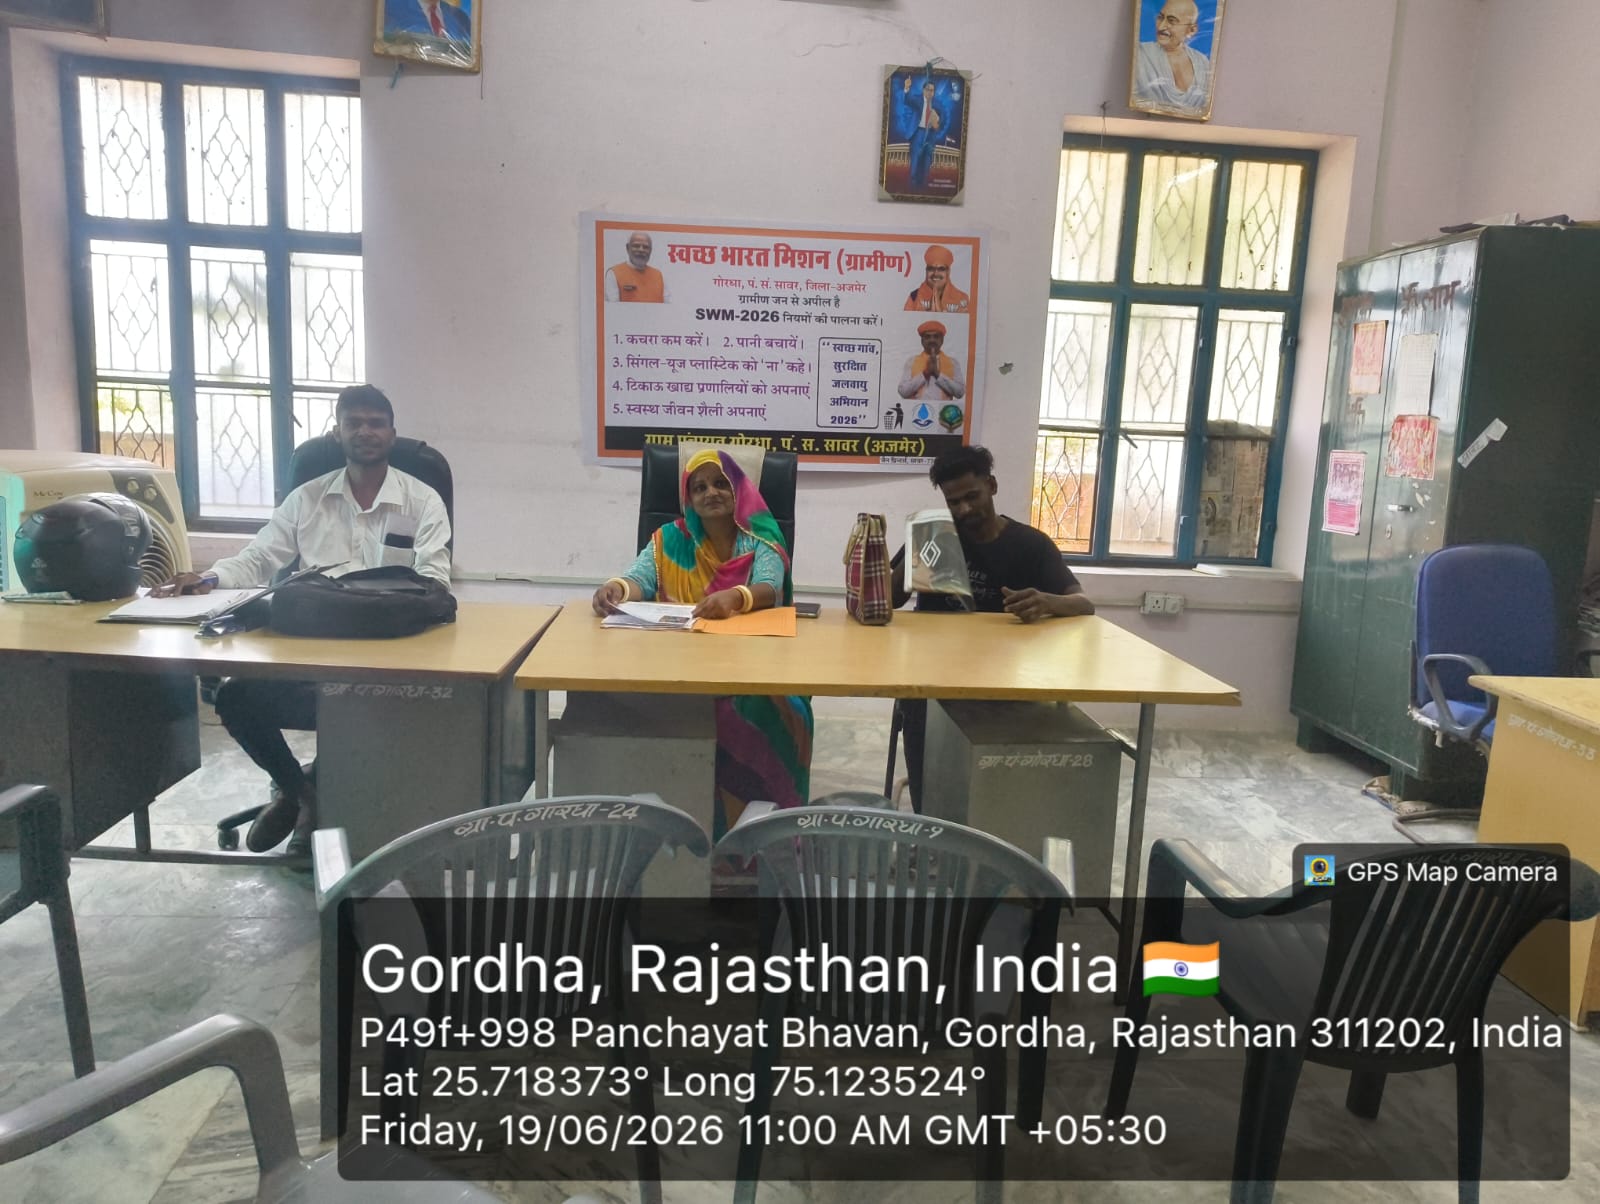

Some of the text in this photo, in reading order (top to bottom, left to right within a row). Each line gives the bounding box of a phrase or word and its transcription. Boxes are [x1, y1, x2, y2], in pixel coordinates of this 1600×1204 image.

[667, 243, 912, 278] स्वच्छ भारत मिशन (ग्रामीण)
[774, 280, 802, 293] सावर,
[738, 293, 841, 309] ग्रामीण जन से अपील है
[695, 308, 780, 323] SWM-2026
[783, 311, 813, 324] नियमों
[815, 312, 828, 324] की
[831, 315, 861, 326] पालना
[613, 334, 623, 345] 1.
[625, 334, 658, 345] कचरा
[661, 335, 681, 346] कम
[723, 336, 734, 348] 2.
[736, 335, 762, 349] पानी
[612, 356, 623, 368] 3.
[626, 354, 686, 374] सिंगल-यूज
[743, 356, 758, 372] को
[833, 360, 867, 373] सुरक्षित
[612, 377, 811, 399] 4. टिकाऊ खाद्य प्रणालियों को अपनाएं
[832, 379, 868, 392] जलवायु
[830, 395, 869, 407] अभियान
[613, 401, 767, 421] 5. स्वस्थ जीवन शैली अपनाएं
[780, 434, 798, 451] पं.
[801, 438, 820, 452] स.
[824, 438, 860, 453] सावर
[864, 436, 926, 457] (अजमेर)
